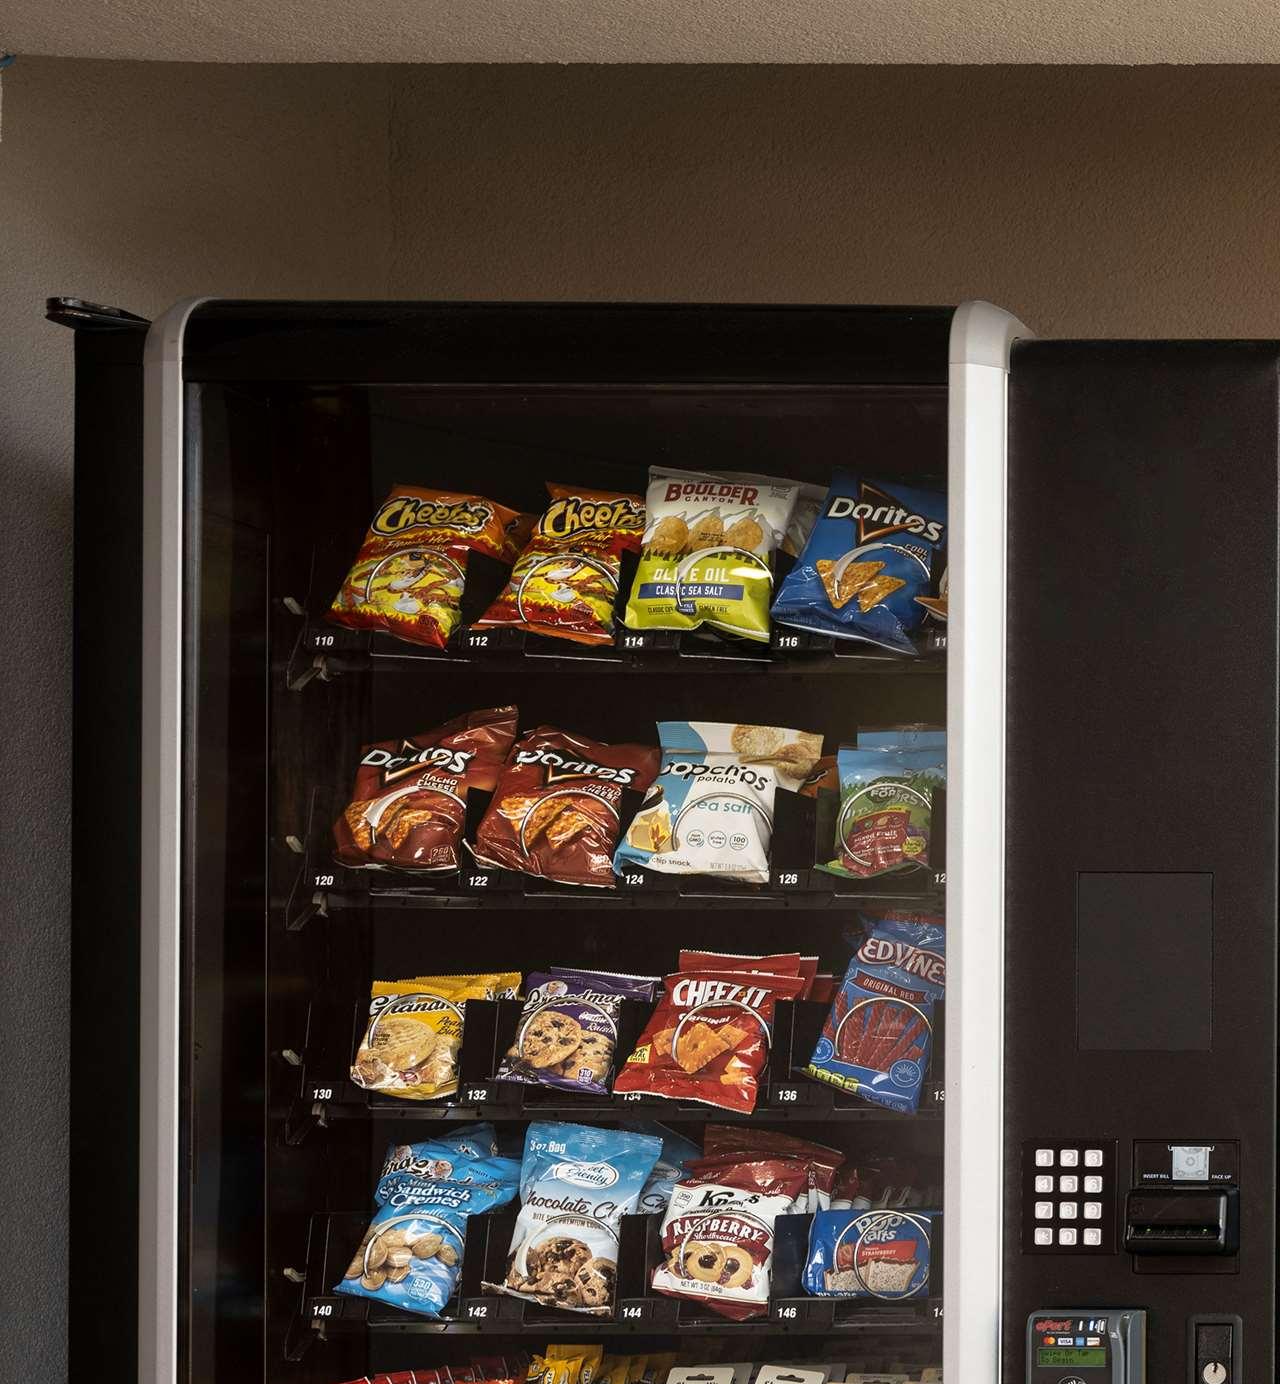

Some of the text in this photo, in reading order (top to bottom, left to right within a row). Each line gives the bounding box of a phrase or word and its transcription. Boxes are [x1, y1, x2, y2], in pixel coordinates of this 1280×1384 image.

[664, 483, 758, 506] BOULDER
[685, 496, 734, 505] CANYON
[374, 497, 487, 534] Cheetos
[828, 497, 944, 541] Doritos
[653, 567, 729, 582] OLIE OIL
[688, 586, 724, 596] SEA SALT
[315, 636, 334, 646] 110
[469, 636, 488, 646] 112
[624, 636, 644, 647] 114
[778, 637, 798, 647] 116
[422, 774, 458, 786] NACHO
[697, 776, 736, 785] potato
[315, 875, 334, 886] 120
[469, 876, 488, 886] 122
[625, 874, 644, 885] 124
[778, 874, 798, 885] 126
[934, 874, 947, 884] 12
[863, 977, 915, 1001] ORIGINAL RED
[313, 1088, 332, 1099] 130
[467, 1090, 486, 1100] 132
[778, 1091, 797, 1101] 136
[530, 1140, 566, 1154] 3 Bag
[394, 1182, 471, 1201] Sandwich
[390, 1193, 461, 1208] Cremes
[692, 1232, 740, 1244] Shortbread
[313, 1305, 332, 1316] 140
[468, 1306, 487, 1317] 142
[622, 1307, 642, 1318] 144
[777, 1307, 797, 1318] 146
